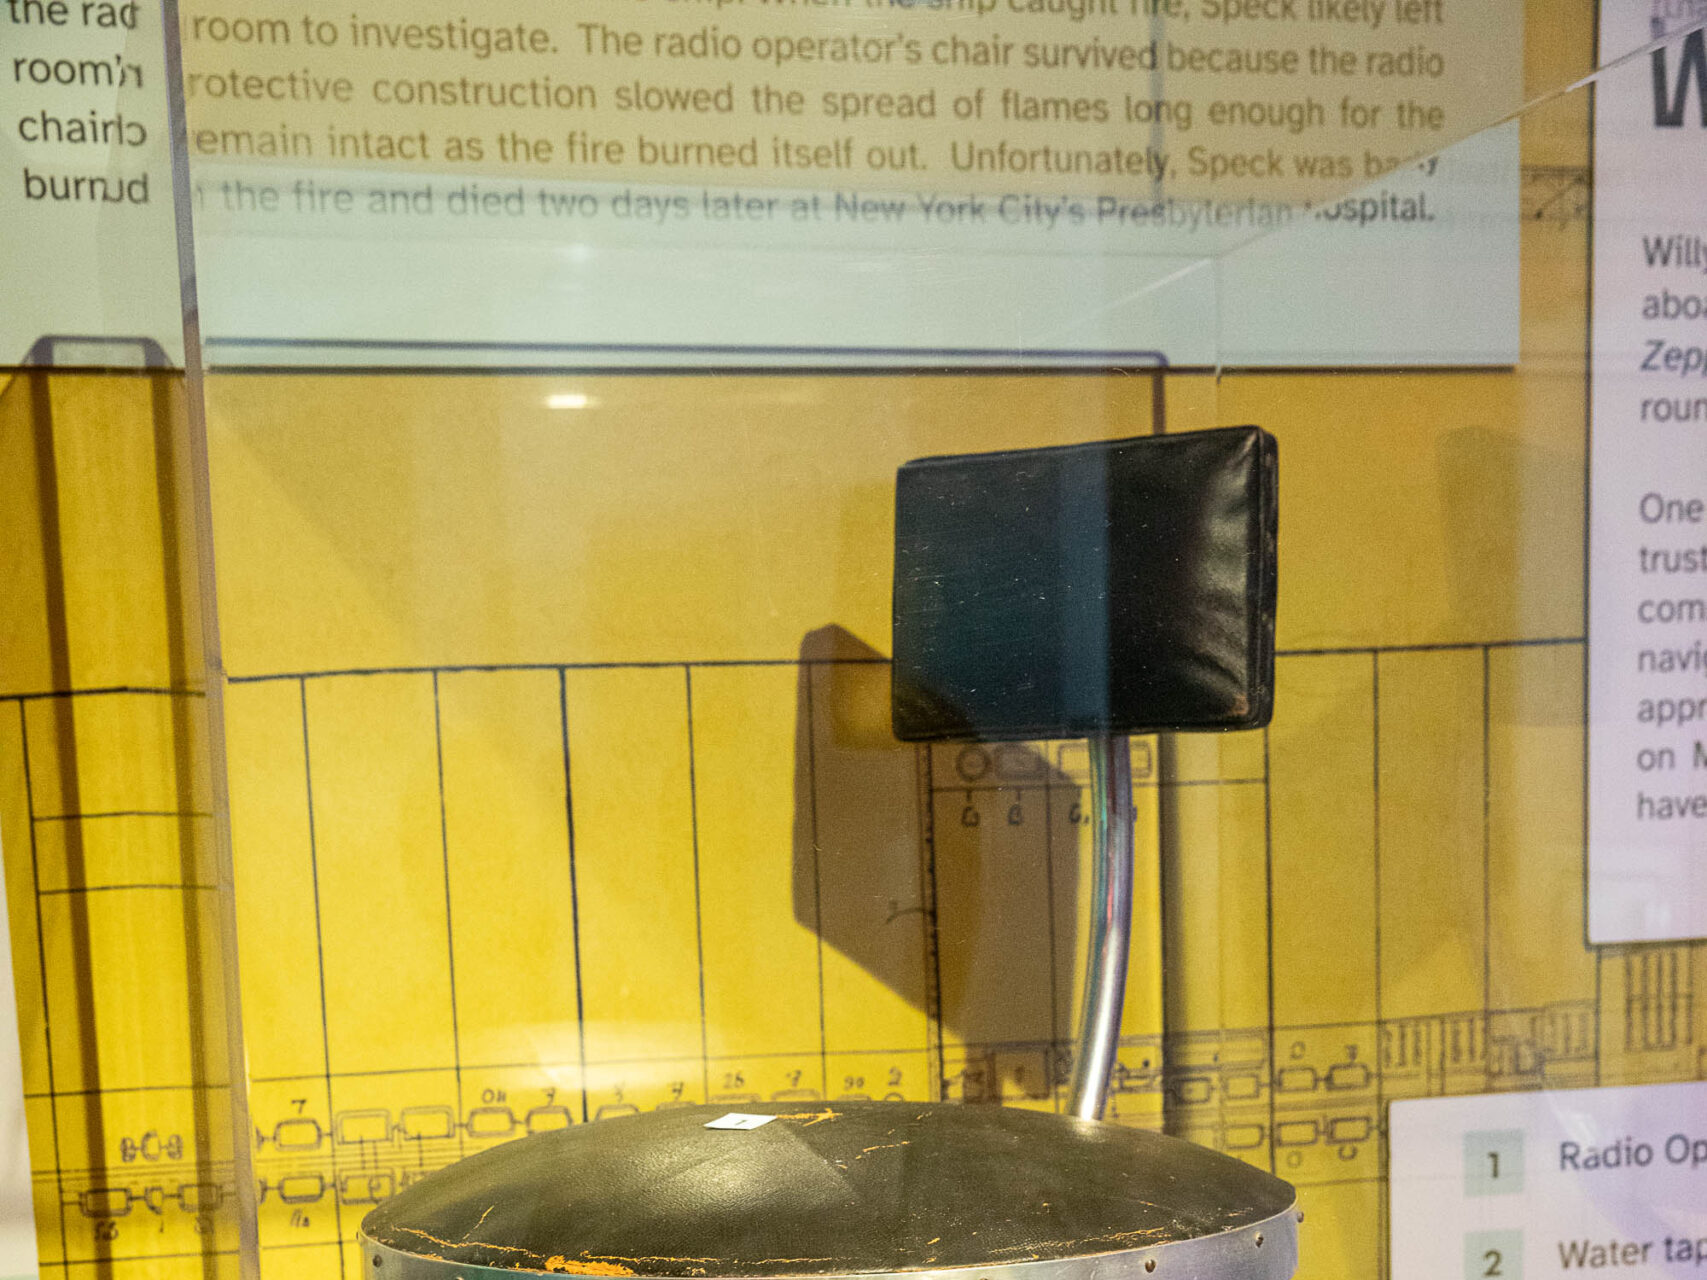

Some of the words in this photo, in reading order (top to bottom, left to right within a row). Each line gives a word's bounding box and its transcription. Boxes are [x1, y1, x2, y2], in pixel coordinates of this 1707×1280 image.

[8, 0, 68, 26] the
[194, 15, 290, 43] room
[302, 15, 338, 47] to
[352, 13, 558, 59] investigate.
[577, 22, 643, 56] The
[655, 25, 742, 60] radio
[753, 33, 922, 67] operator's
[932, 33, 1013, 65] chair
[1023, 36, 1157, 70] survived
[1168, 41, 1299, 74] because
[1309, 47, 1357, 76] the
[1367, 46, 1445, 77] radio
[373, 75, 597, 109] construction
[615, 79, 733, 112] slowed
[752, 83, 804, 115] the
[822, 89, 936, 121] spread
[953, 88, 984, 120] of
[1002, 88, 1109, 122] flames
[1125, 95, 1192, 132] long
[1208, 99, 1324, 134] enough
[1340, 96, 1382, 127] for
[1397, 99, 1445, 130] the
[329, 125, 429, 159] intact
[445, 136, 484, 162] as
[498, 131, 553, 163] the
[566, 131, 624, 164] fire
[639, 135, 757, 167] burned
[773, 136, 853, 169] itself
[866, 142, 927, 170] out.
[952, 141, 1176, 181] Unfortunately,
[1189, 145, 1285, 183] Speck
[1294, 152, 1353, 178] was
[1365, 150, 1440, 177] bay
[222, 180, 279, 213] the
[294, 180, 353, 214] fire
[368, 186, 432, 216] and
[449, 187, 525, 217] died
[539, 190, 598, 218] two
[612, 189, 690, 224] days
[703, 190, 779, 219] later
[791, 194, 820, 220] at
[835, 193, 905, 222] New
[917, 194, 985, 222] York
[1304, 190, 1435, 227] ospital.
[1640, 338, 1707, 377] Zep
[1639, 492, 1704, 524] One
[1637, 640, 1707, 677] navi
[1637, 748, 1675, 771] on
[1487, 1151, 1500, 1179] 1
[1560, 1134, 1654, 1171] Radio
[1483, 1249, 1503, 1277] 2
[1558, 1238, 1653, 1270] Water
